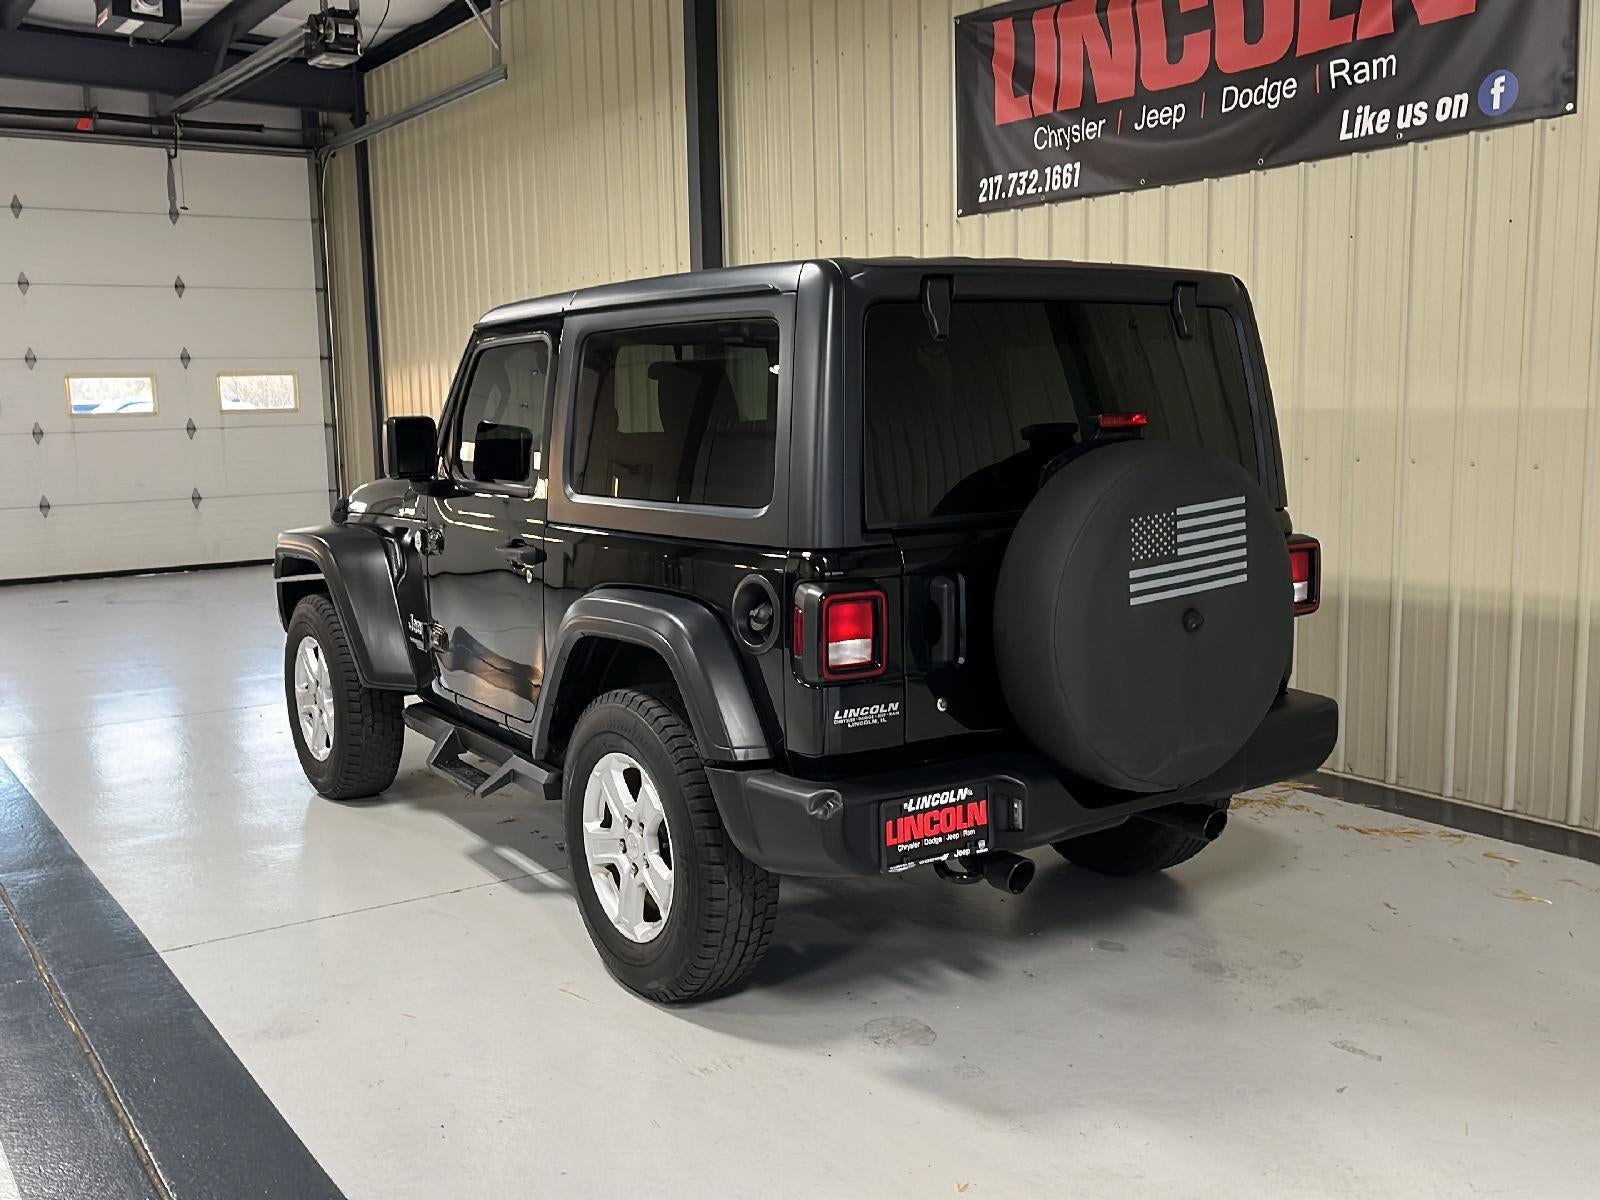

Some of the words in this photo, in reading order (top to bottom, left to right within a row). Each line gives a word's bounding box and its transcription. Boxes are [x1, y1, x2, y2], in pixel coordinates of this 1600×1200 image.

[1033, 117, 1106, 151] Chrysler
[1134, 103, 1186, 131] Jeep
[1221, 77, 1298, 114] Dodge
[1329, 54, 1397, 89] Ram
[1339, 105, 1391, 141] Like
[1396, 100, 1428, 130] us
[1435, 92, 1469, 122] on
[978, 161, 1081, 203] 217.732.1661
[833, 702, 900, 720] LINCOLN
[848, 718, 879, 728] LINCOLN,
[907, 787, 969, 812] LINCOLN
[886, 799, 988, 847] LINCOLN
[945, 832, 960, 841] Jeep
[953, 848, 971, 858] Jeep
